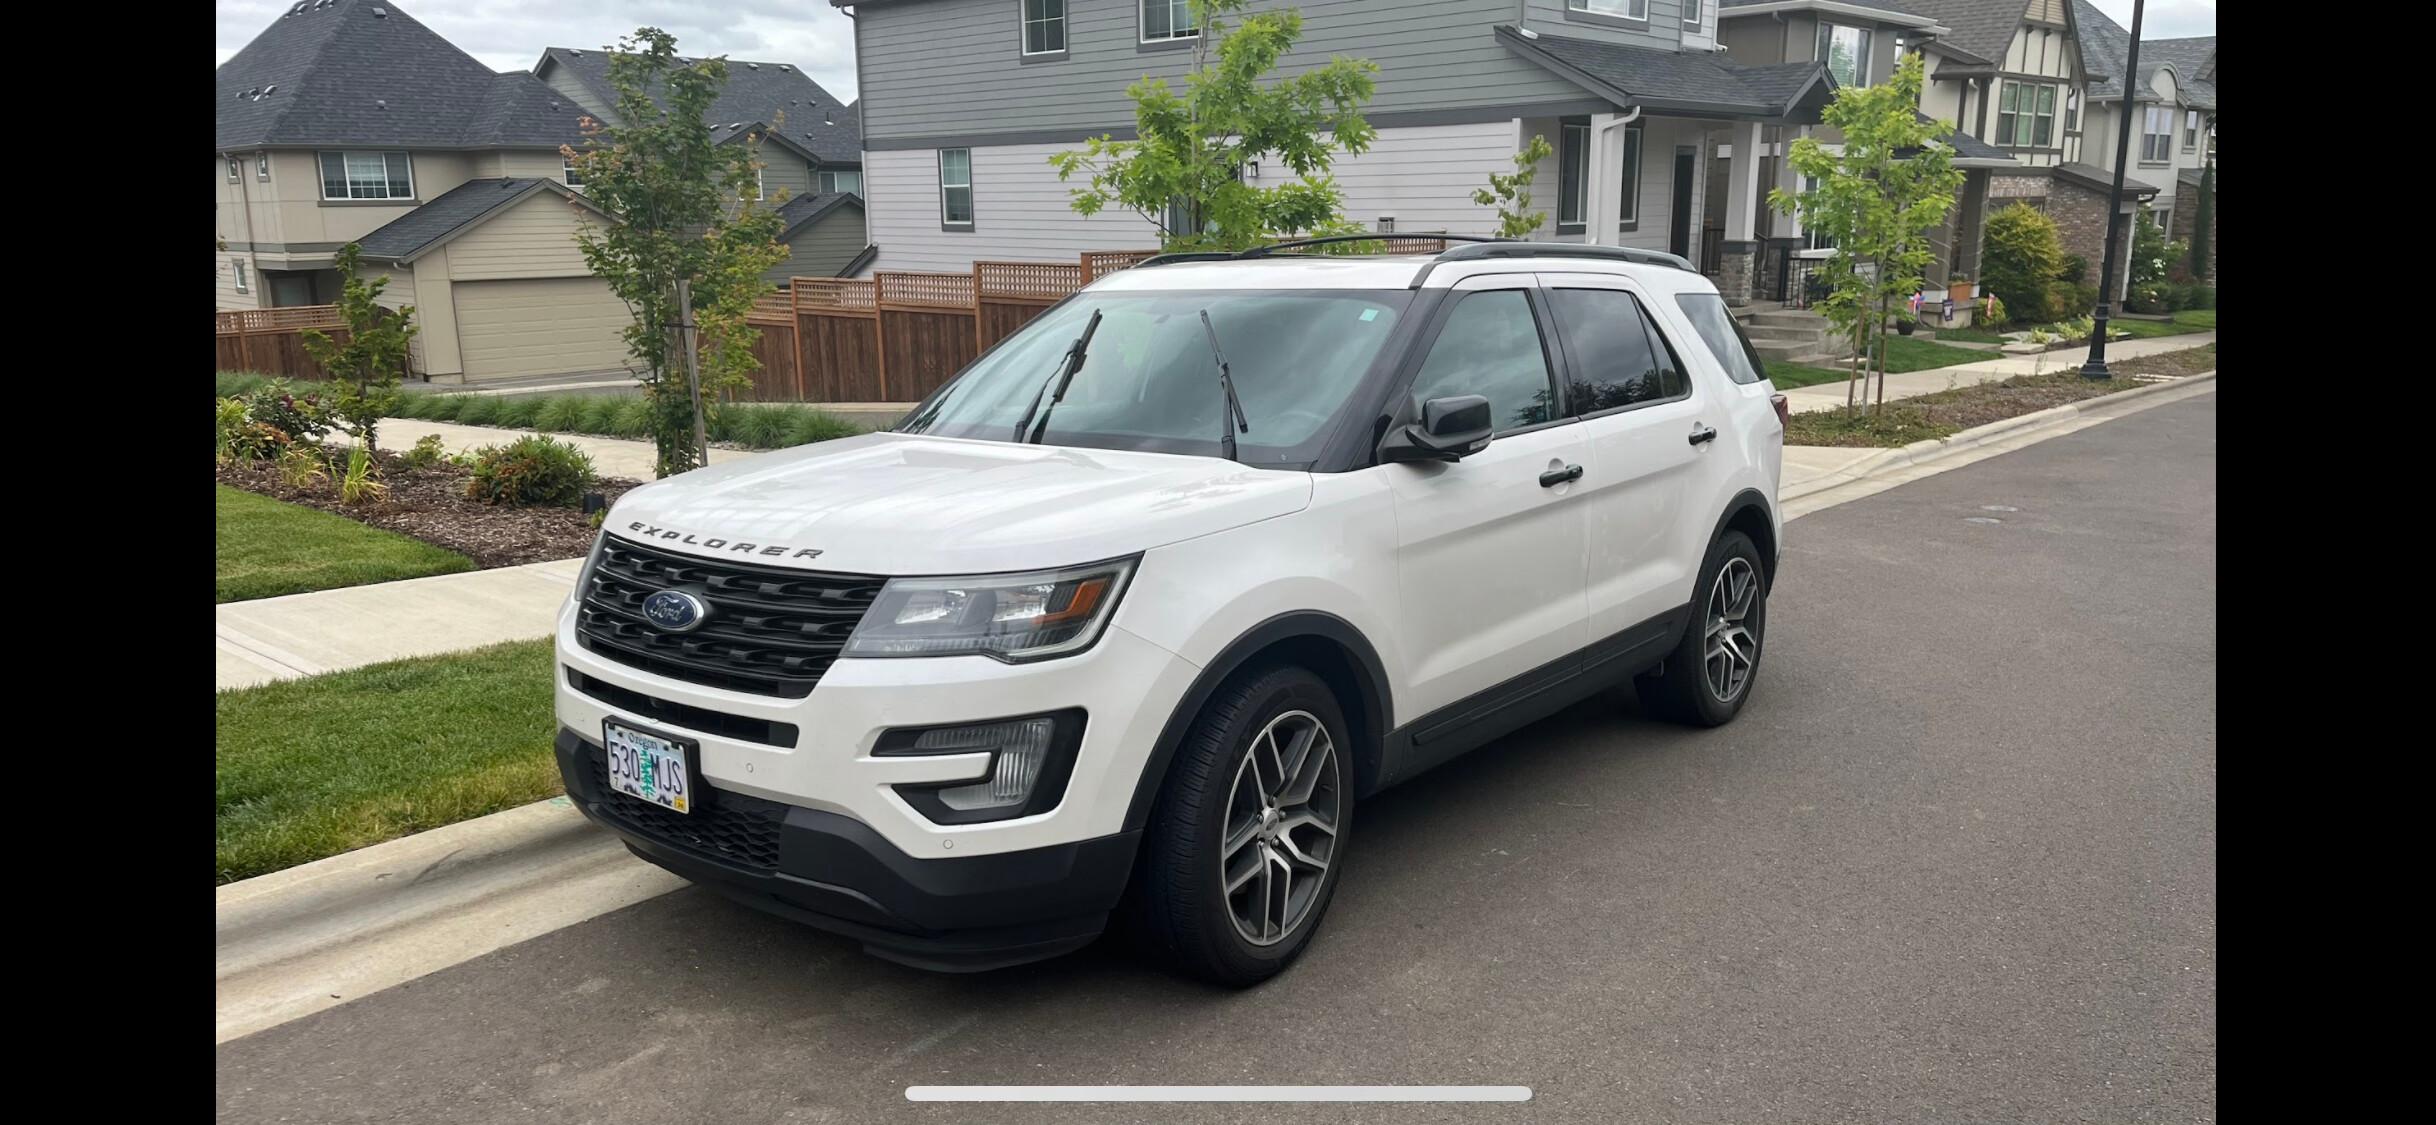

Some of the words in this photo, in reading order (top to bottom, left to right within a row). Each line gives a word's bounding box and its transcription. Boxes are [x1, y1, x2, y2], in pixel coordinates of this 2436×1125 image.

[628, 521, 824, 559] EXPLORER
[650, 595, 685, 621] Ford
[610, 741, 640, 782] 530
[650, 752, 683, 795] MJS
